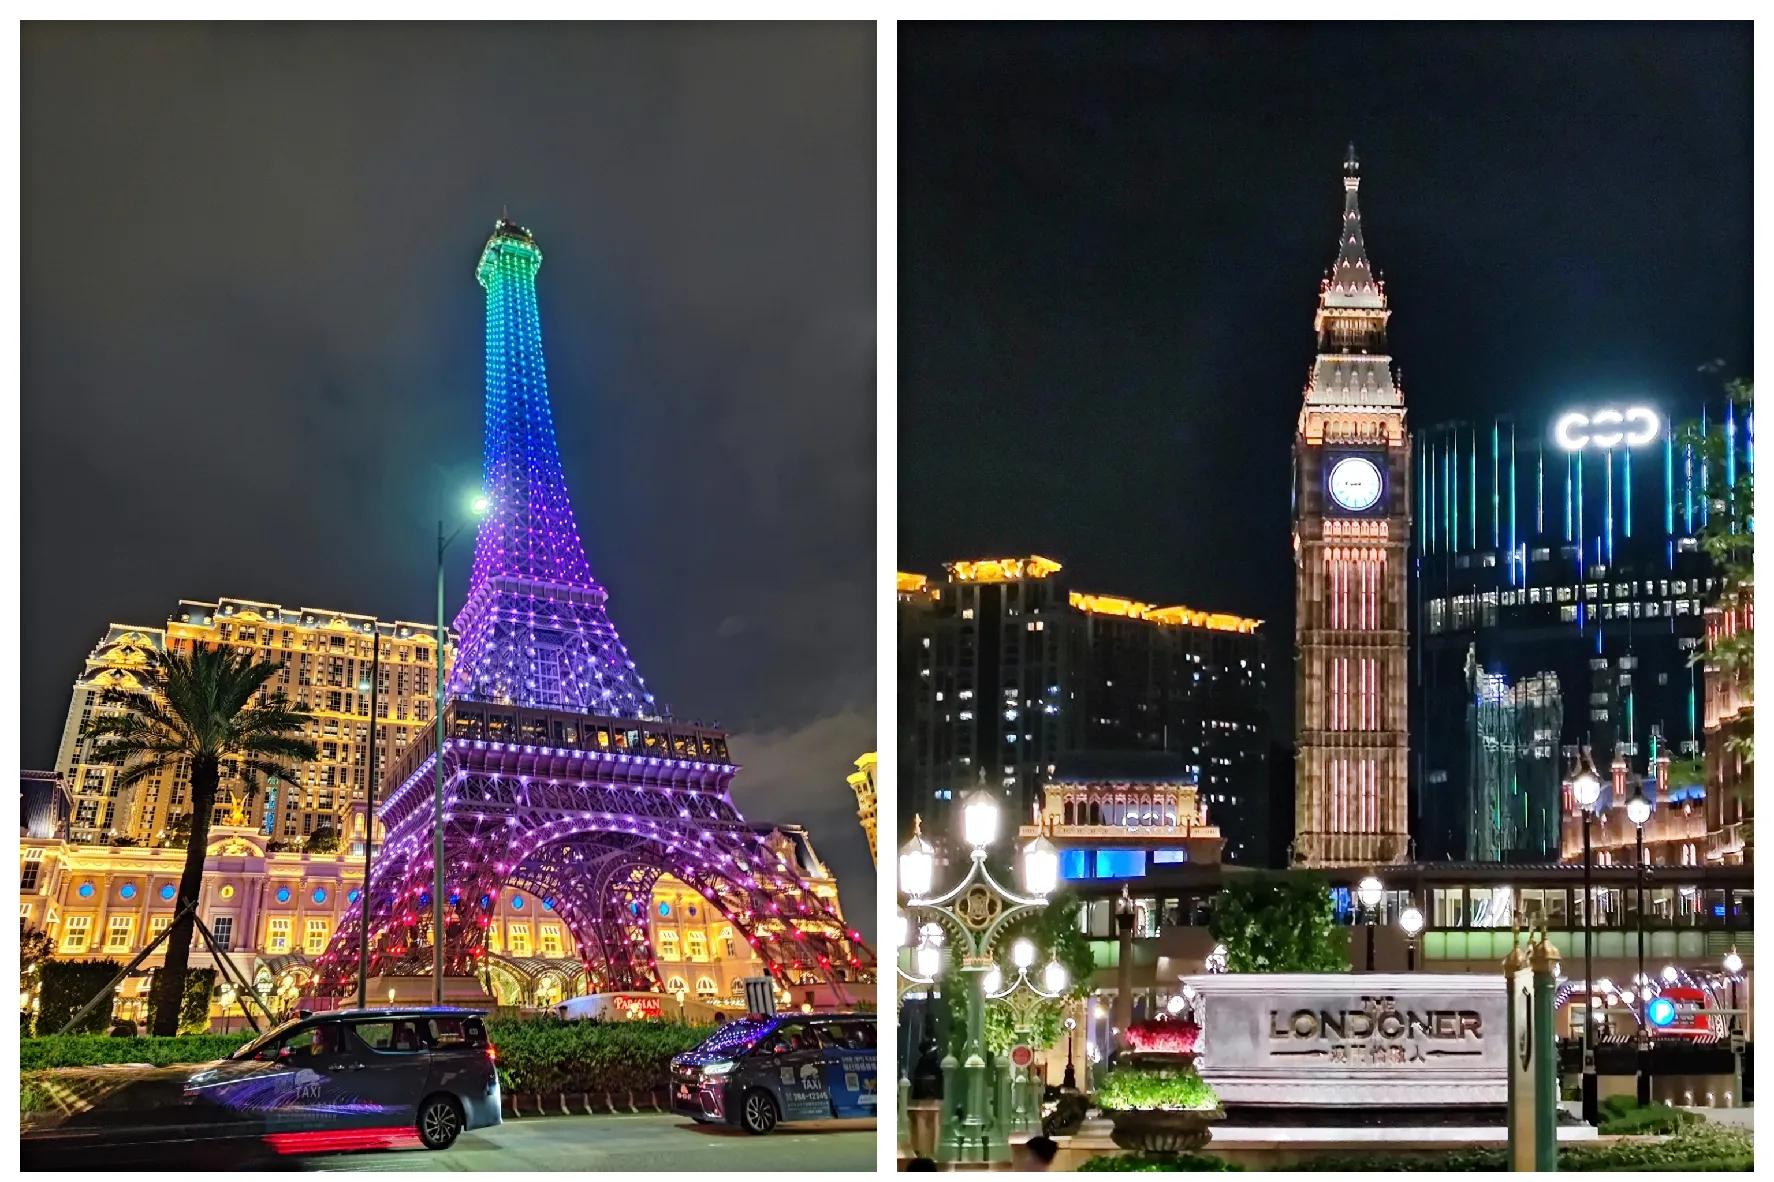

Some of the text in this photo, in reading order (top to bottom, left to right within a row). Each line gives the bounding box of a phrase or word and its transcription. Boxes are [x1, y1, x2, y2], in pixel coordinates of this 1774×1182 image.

[1269, 1009, 1483, 1039] LONDONER
[801, 1079, 822, 1090] TAXI
[295, 1085, 321, 1098] TAXI
